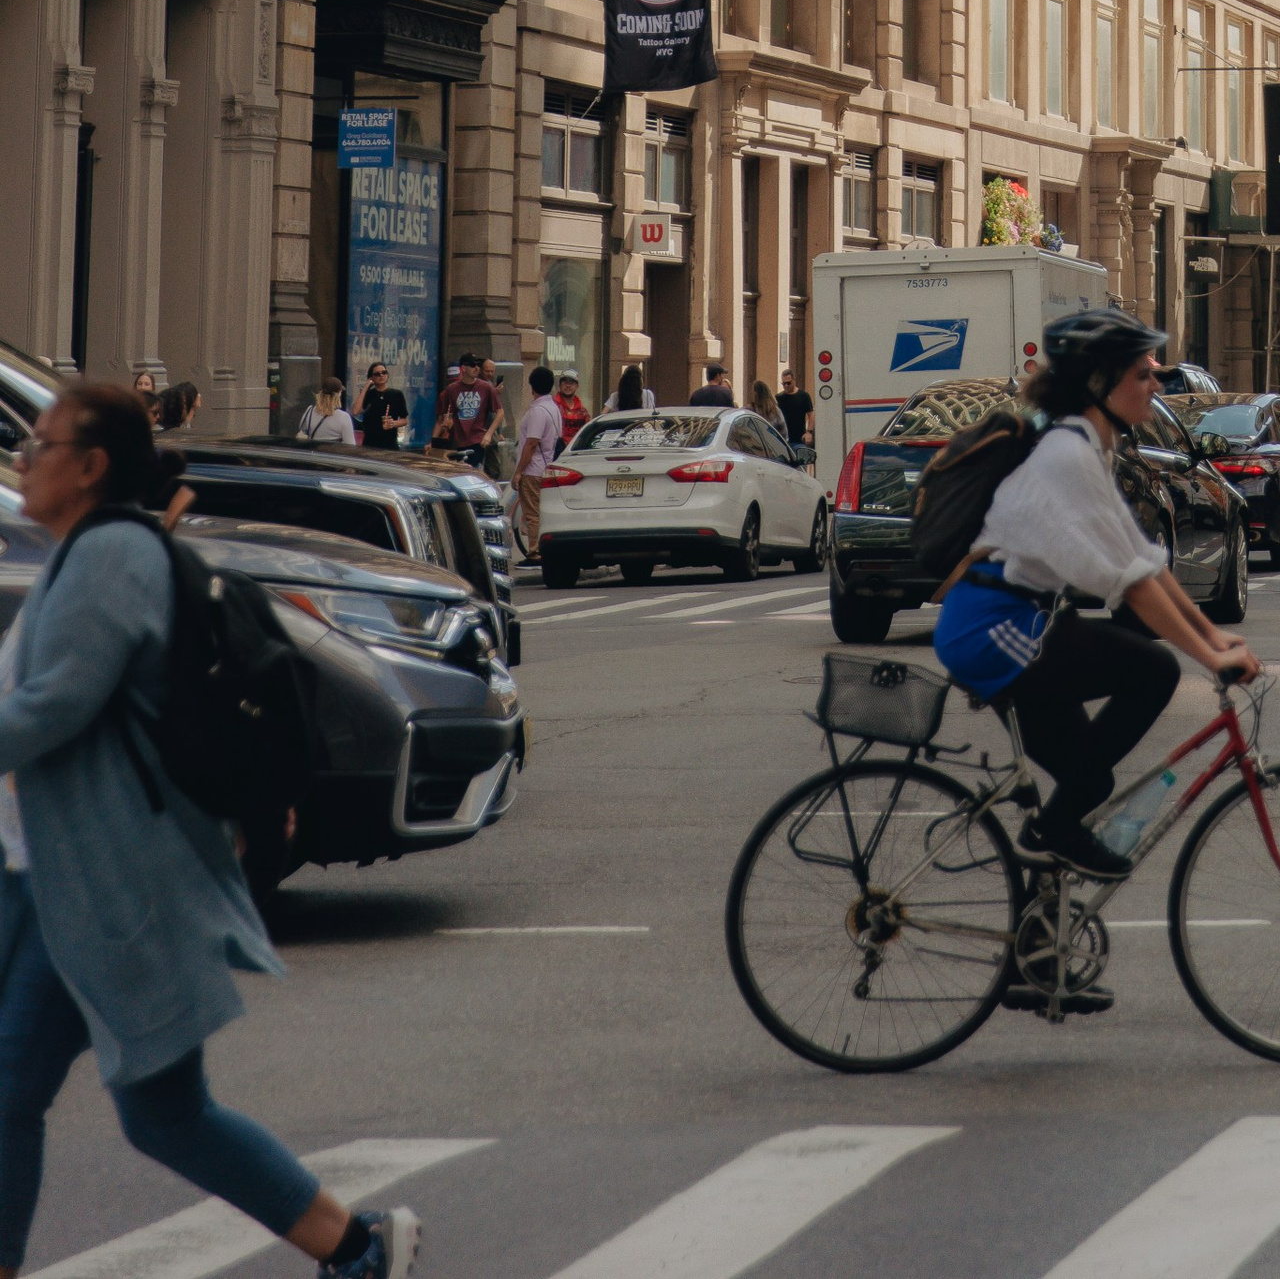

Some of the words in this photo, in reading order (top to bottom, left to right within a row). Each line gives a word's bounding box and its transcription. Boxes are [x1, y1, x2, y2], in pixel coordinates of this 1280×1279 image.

[616, 13, 673, 34] COMING
[638, 38, 663, 46] Tattoo
[655, 48, 674, 56] NYC
[341, 113, 367, 121] RETAIL
[368, 112, 393, 120] SPACE
[364, 119, 388, 127] LEASE
[352, 168, 396, 201] RETAIL
[398, 170, 438, 209] SPACE
[360, 205, 387, 242] FOR
[389, 209, 427, 246] LEASE
[906, 278, 948, 288] 7533773
[547, 335, 576, 362] Wilson
